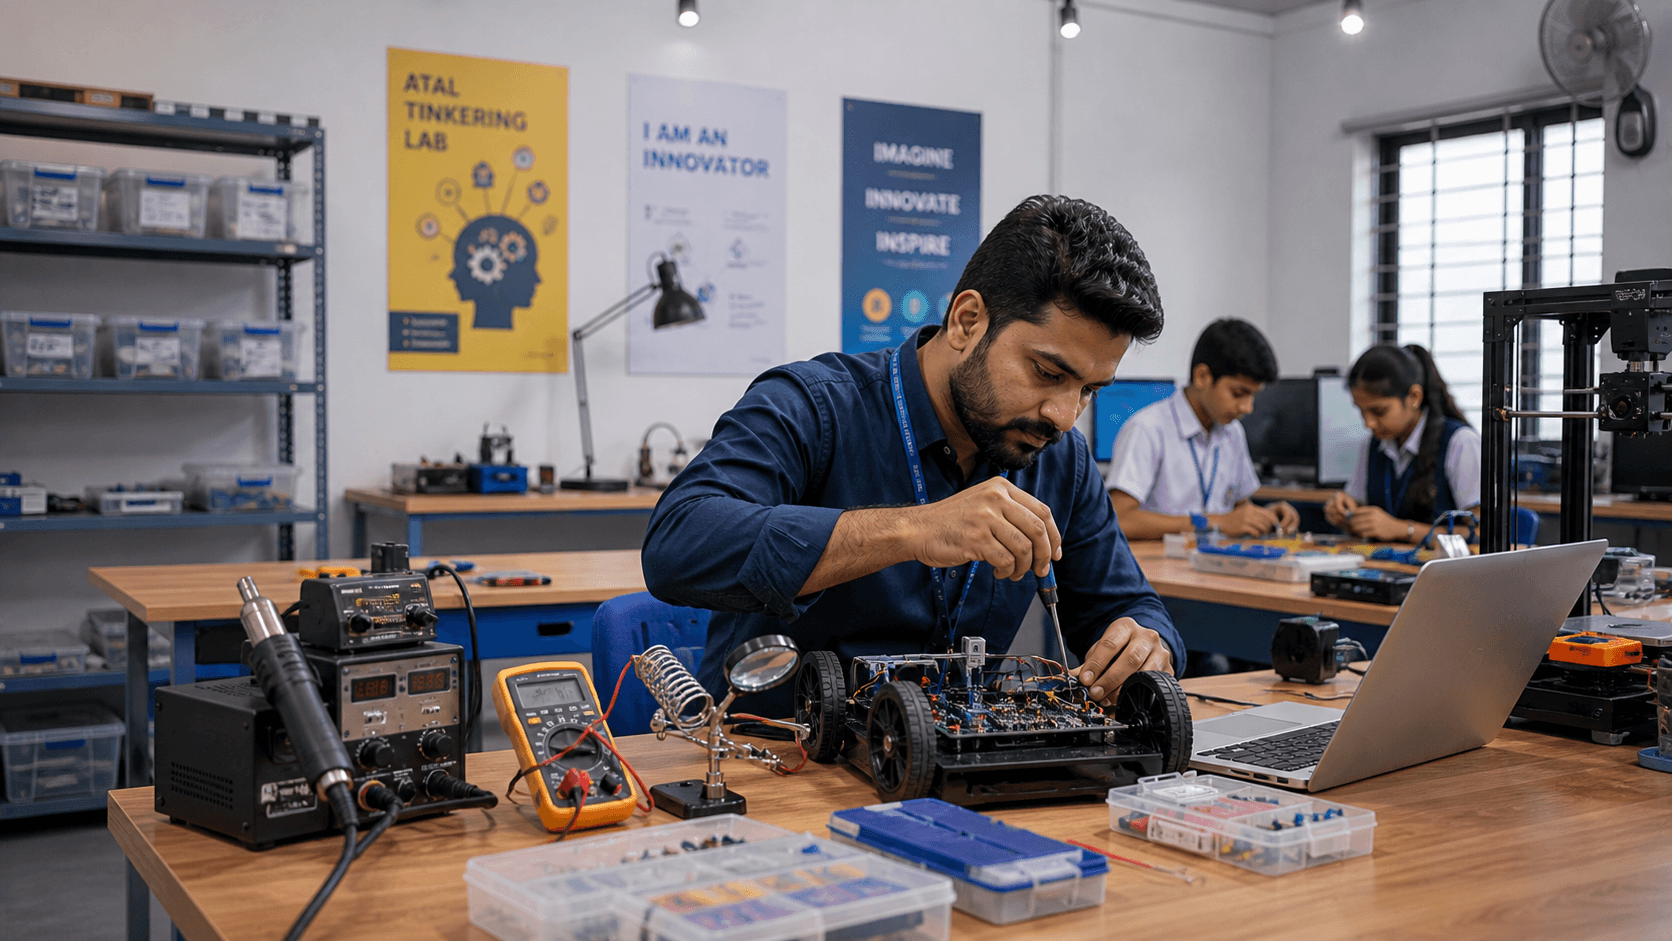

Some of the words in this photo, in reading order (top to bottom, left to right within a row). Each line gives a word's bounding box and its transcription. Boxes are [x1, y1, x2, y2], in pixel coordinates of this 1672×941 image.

[404, 73, 460, 98] ATAL
[404, 101, 527, 132] TINKERING
[404, 130, 448, 152] LAB
[643, 121, 650, 140] I
[658, 123, 691, 143] AM
[698, 127, 728, 147] AN
[643, 149, 769, 178] INNOVATOR
[873, 141, 954, 170] IMAGINE
[865, 188, 961, 215] INNOVATE
[876, 231, 951, 256] INSPIRE
